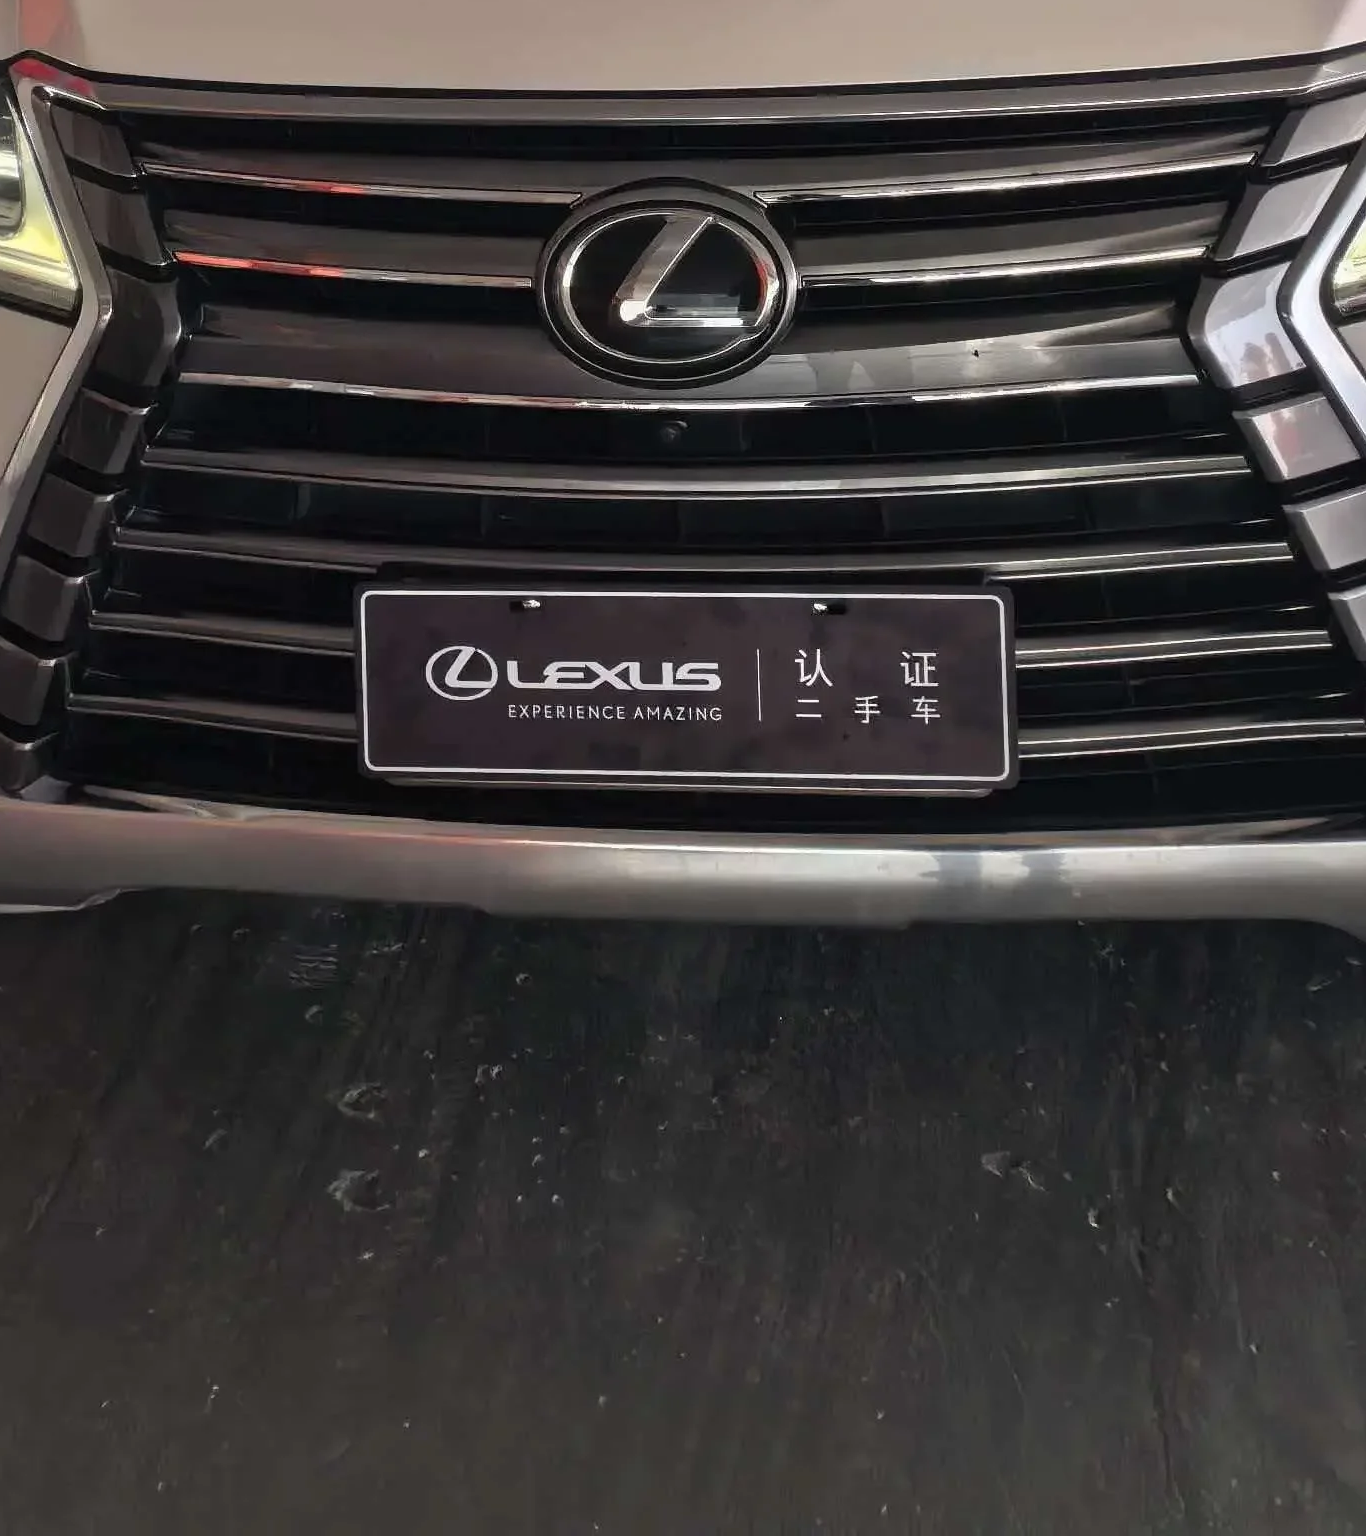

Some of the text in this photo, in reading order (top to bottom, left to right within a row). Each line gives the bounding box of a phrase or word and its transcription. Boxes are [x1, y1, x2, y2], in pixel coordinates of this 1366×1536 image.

[506, 660, 722, 692] LEXUS
[794, 648, 940, 689] 认证
[507, 703, 723, 723] EXPERIENCE AMAZING
[794, 694, 942, 725] 二手车
